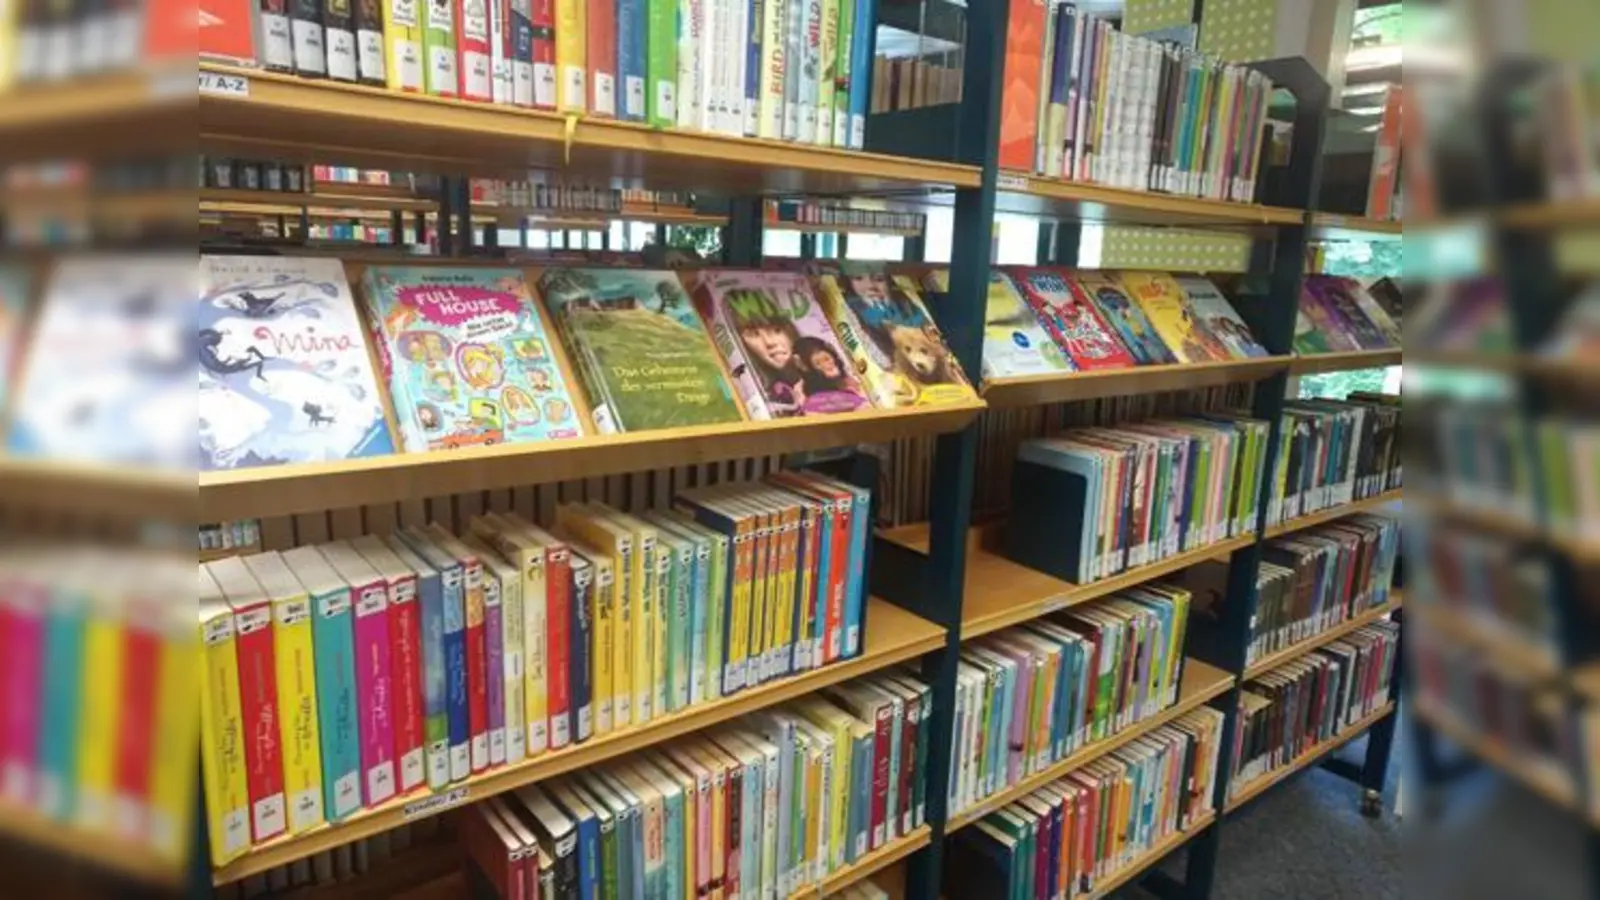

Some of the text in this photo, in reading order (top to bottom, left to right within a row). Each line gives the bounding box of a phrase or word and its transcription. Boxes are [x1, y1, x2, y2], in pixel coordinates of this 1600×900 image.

[217, 77, 244, 91] A-Z
[771, 49, 784, 94] BIRD
[415, 289, 501, 315] FULL HOUSE
[253, 326, 359, 354] Mina
